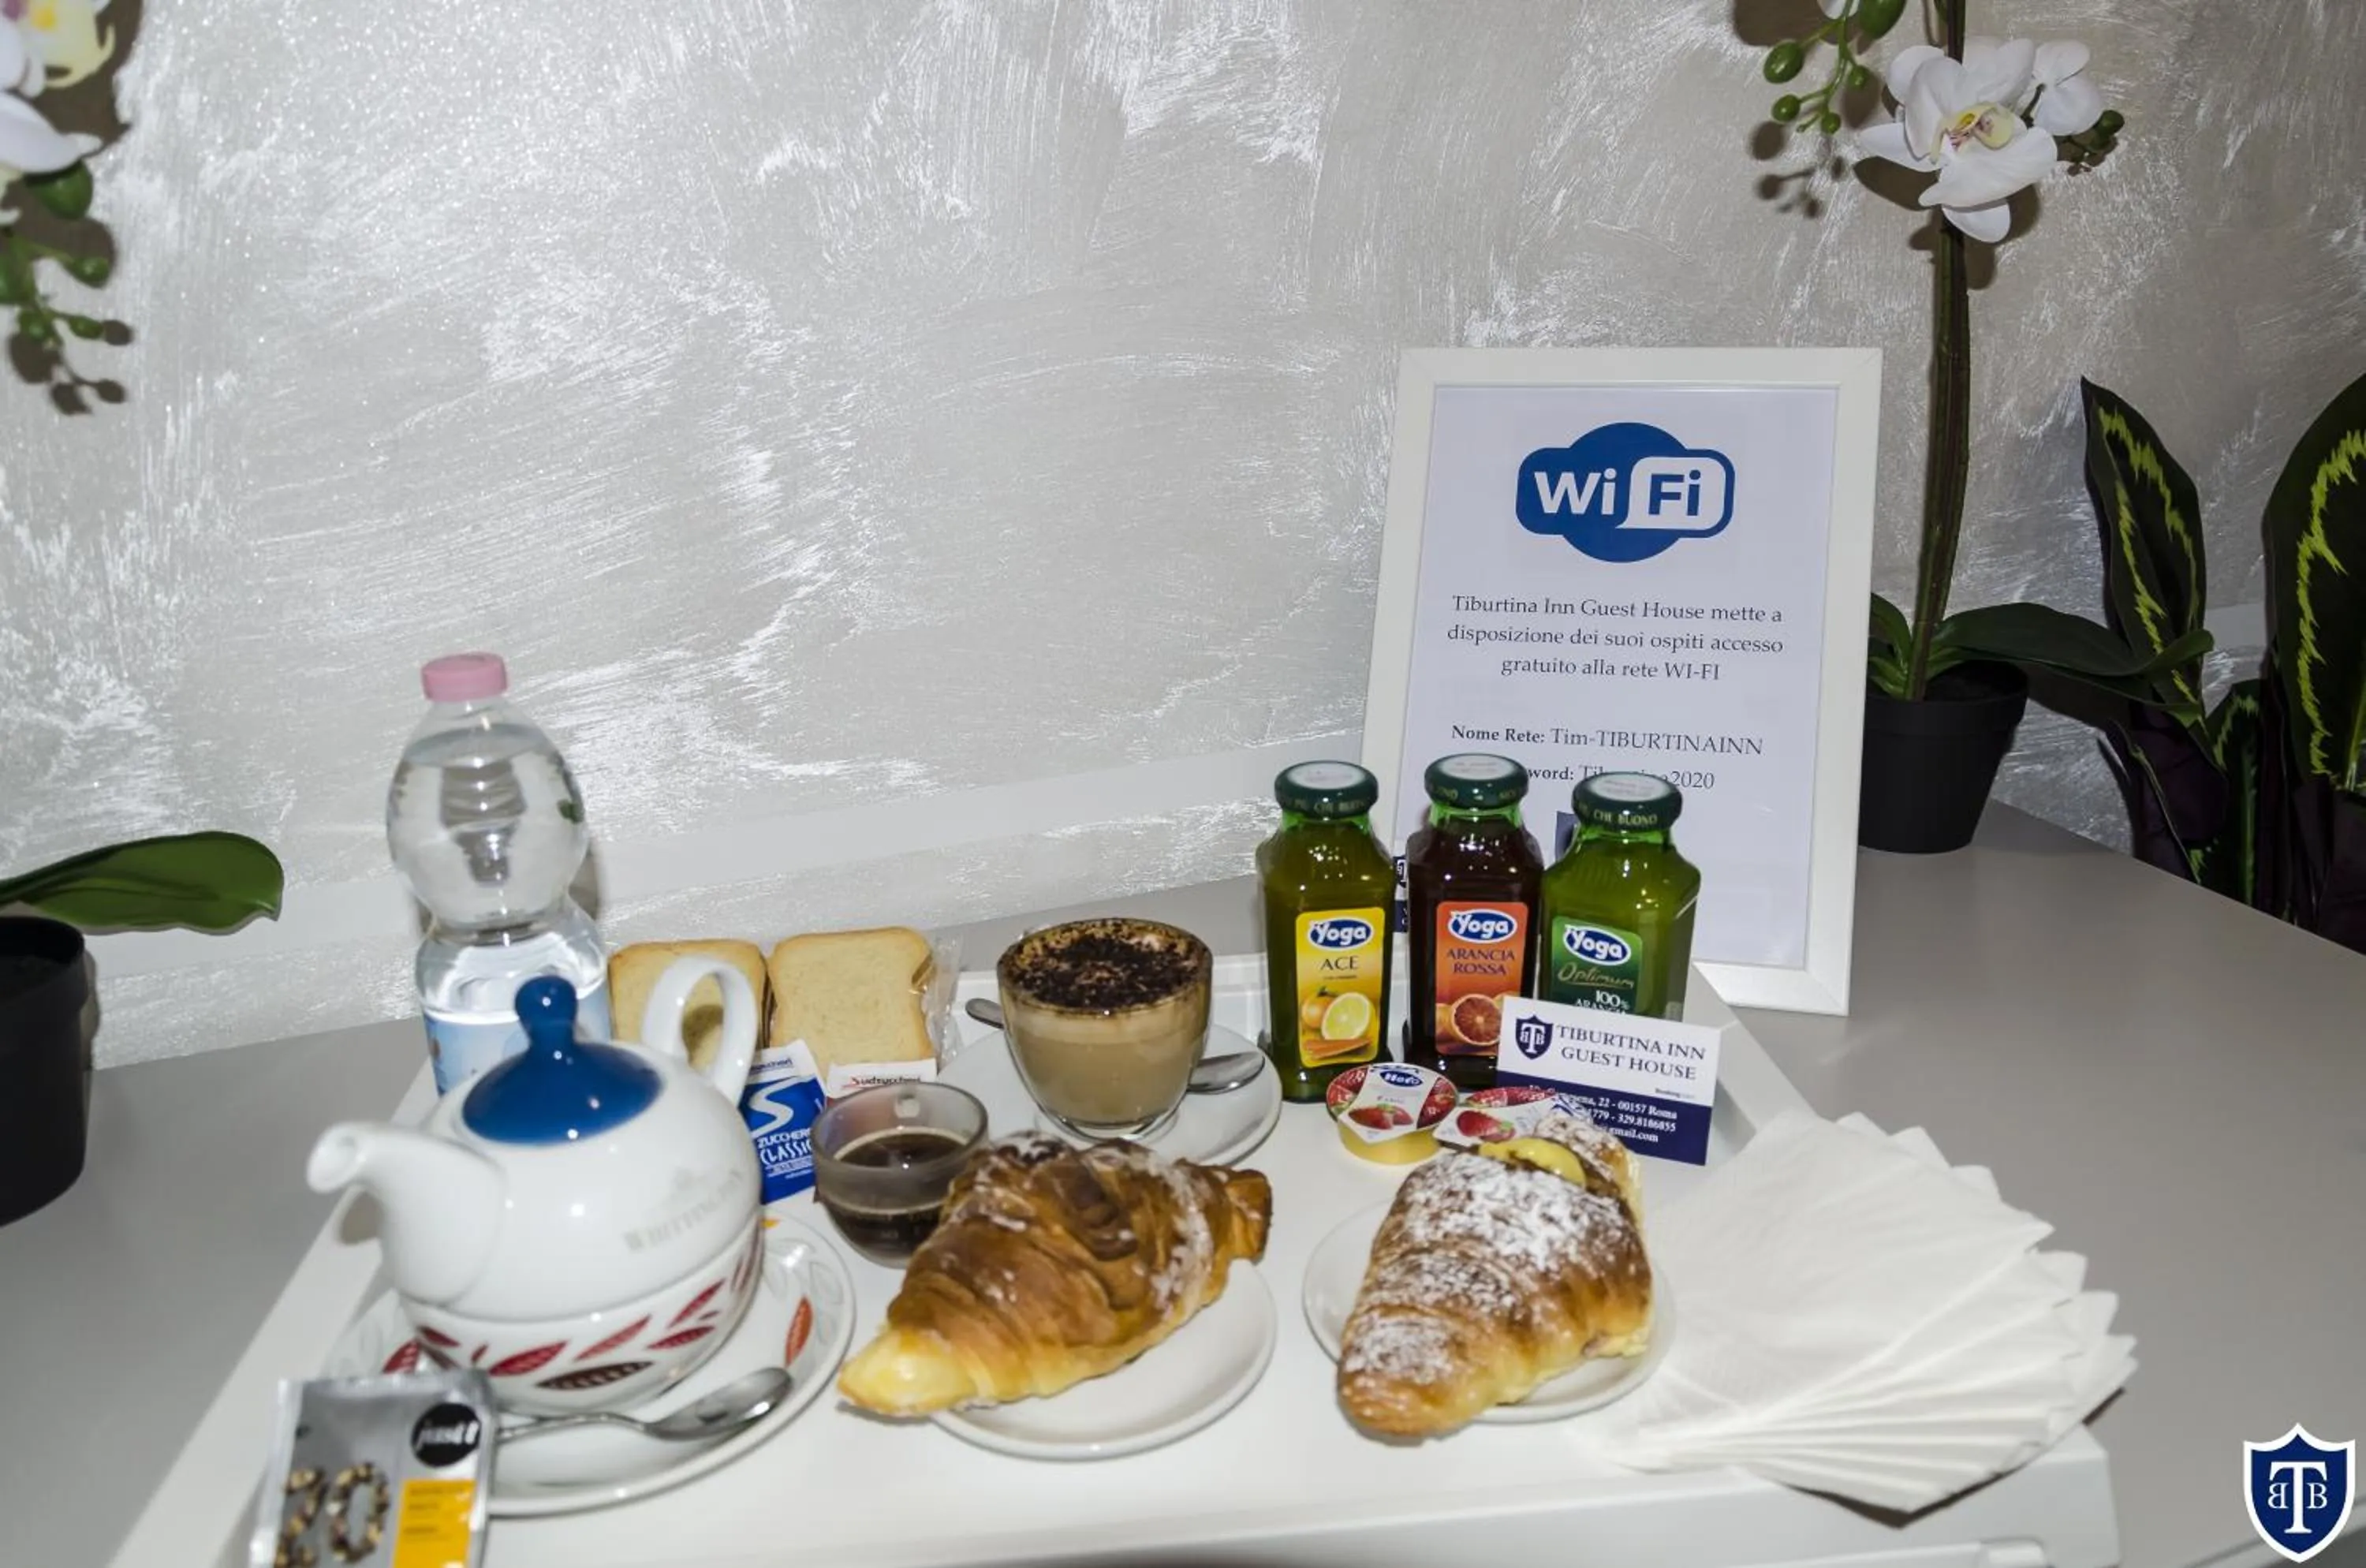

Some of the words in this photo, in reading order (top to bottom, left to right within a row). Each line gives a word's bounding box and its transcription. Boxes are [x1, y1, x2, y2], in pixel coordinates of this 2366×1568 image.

[1452, 595, 1537, 613] Tiburtina
[1543, 598, 1575, 614] Inn
[1580, 599, 1636, 617] Guest
[1642, 602, 1704, 619] House
[1711, 607, 1767, 622] mette
[1771, 609, 1783, 622] a
[1447, 625, 1565, 645] disposizione
[1569, 629, 1599, 644] dei
[1603, 633, 1644, 647] suoi
[1650, 633, 1704, 653] ospiti
[1711, 637, 1784, 653] accesso
[1501, 657, 1577, 676] gratuito
[1581, 659, 1615, 676] alla
[1621, 663, 1658, 678] rete
[1665, 662, 1719, 681] WI-FI
[1451, 725, 1499, 741] Nome
[1505, 728, 1544, 743] Rete:
[1551, 727, 1763, 756] Tim-TIBURTINAINN
[1528, 767, 1574, 781] word:
[1312, 921, 1368, 946] Yoga
[1451, 912, 1510, 939] Yoga
[1446, 948, 1515, 961] ARANCIA
[1566, 927, 1623, 960] Yoga
[1320, 956, 1359, 971] ACE
[1454, 963, 1506, 975] ROSSA
[1557, 1025, 1662, 1055] TIBURTINA
[1667, 1042, 1707, 1060] INN
[1561, 1046, 1623, 1066] GUEST
[1630, 1058, 1696, 1081] HOUSE
[757, 1128, 812, 1149] ZUCCHER
[759, 1140, 813, 1166] CLASSIC
